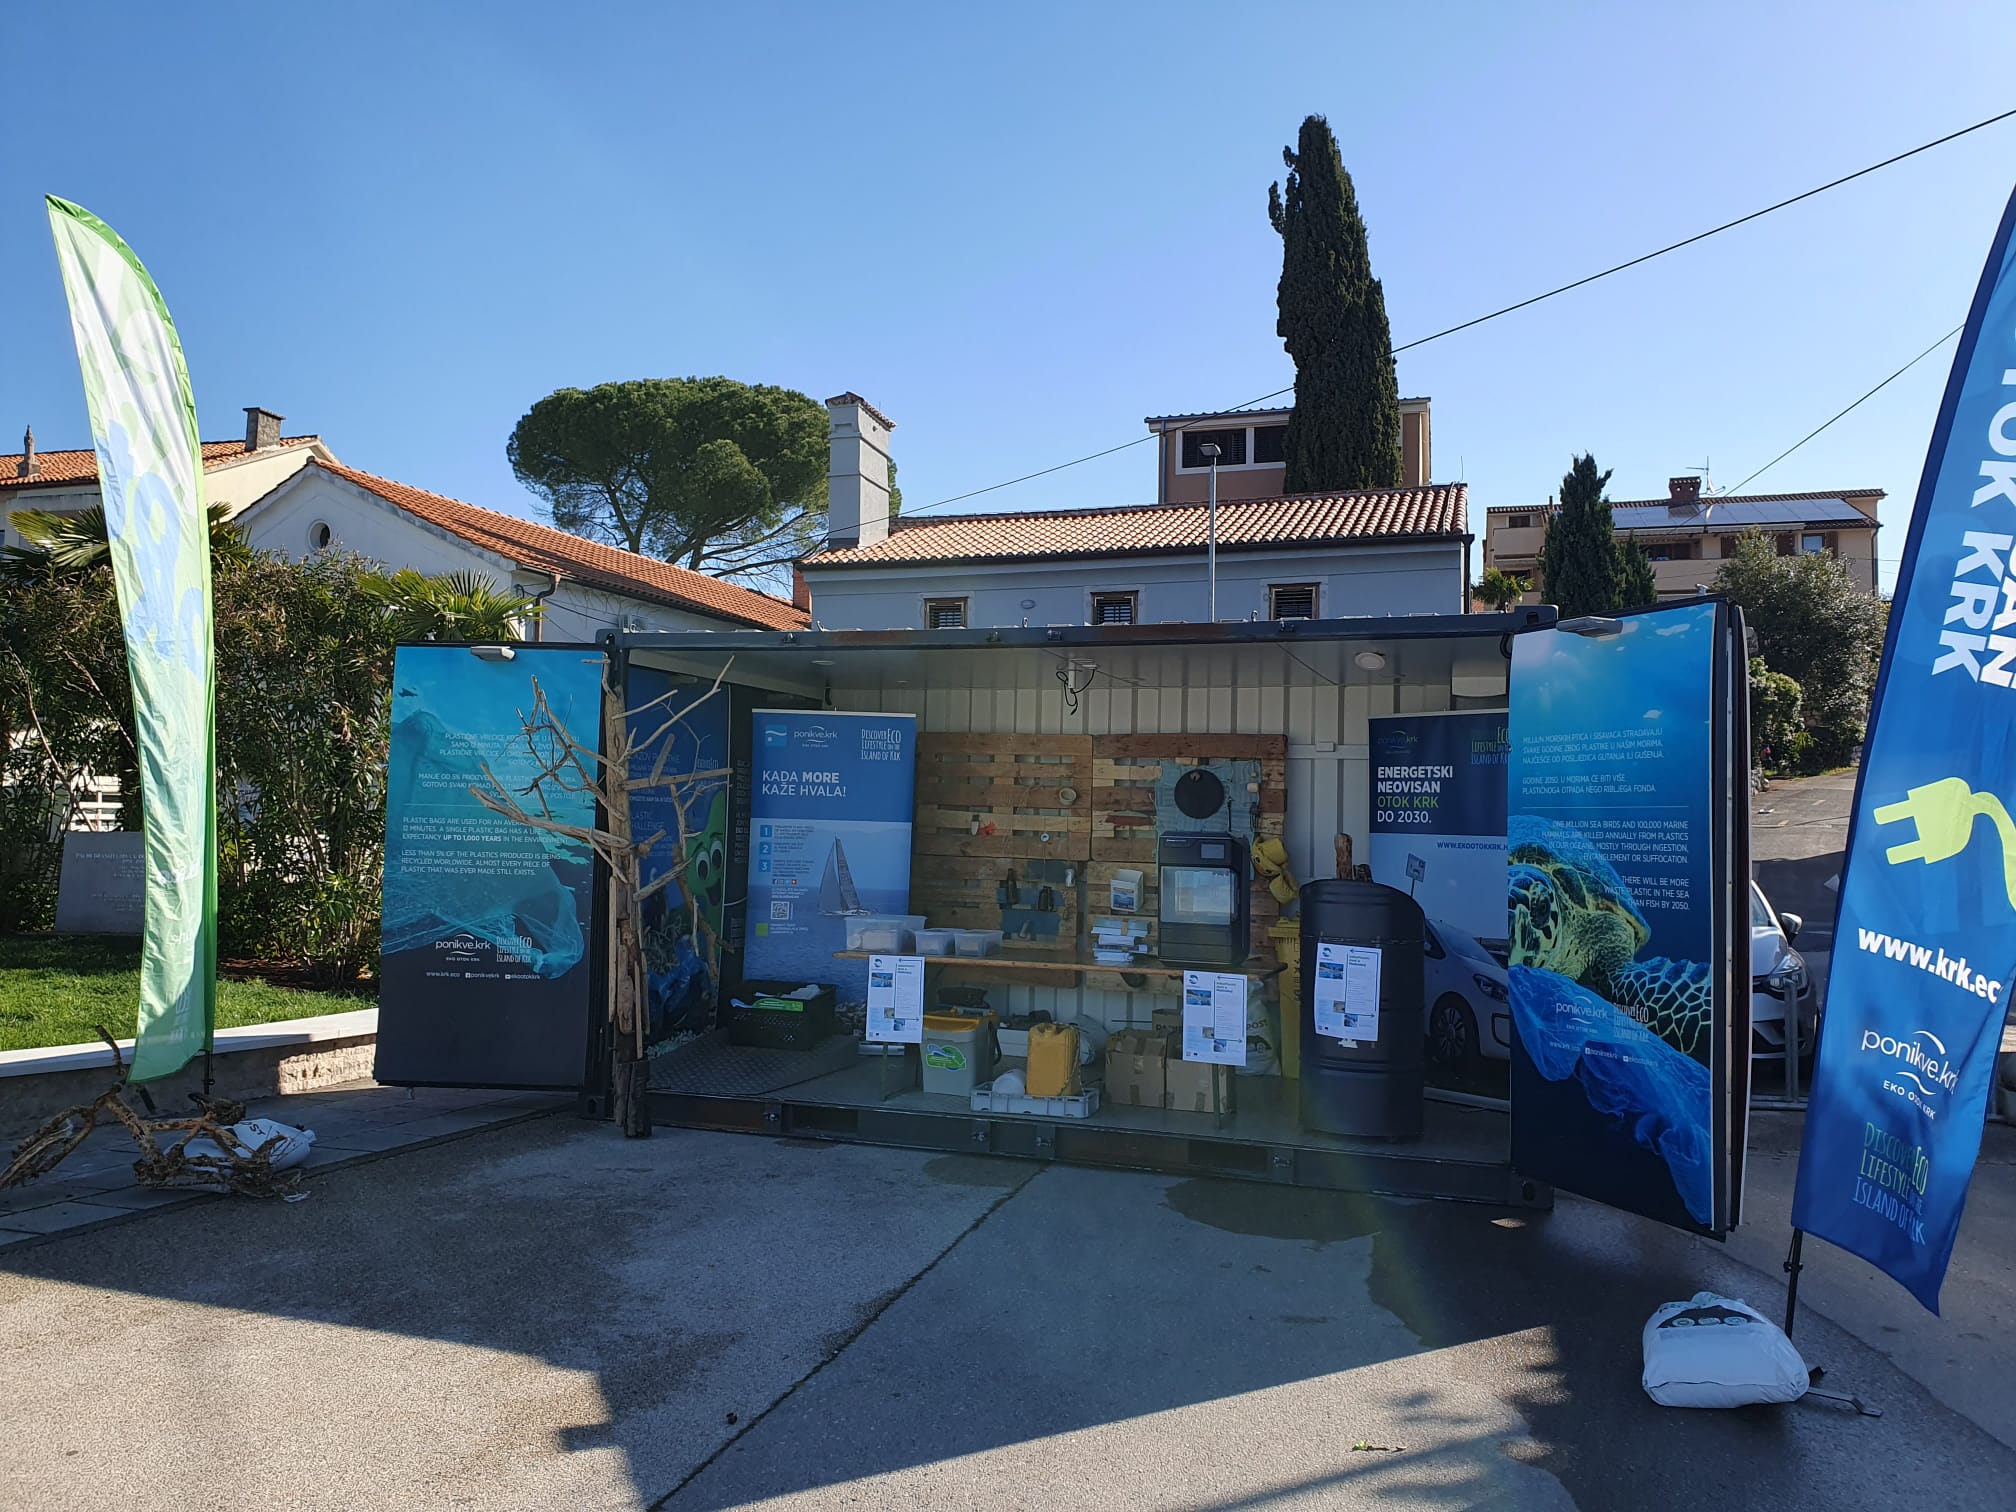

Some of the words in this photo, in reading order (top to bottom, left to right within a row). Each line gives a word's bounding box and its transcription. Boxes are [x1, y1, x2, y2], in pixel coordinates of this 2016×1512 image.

[1932, 530, 2013, 683] KRK
[887, 728, 901, 744] ECO
[861, 750, 881, 760] ISLAND
[763, 770, 798, 782] KADA
[803, 772, 839, 783] MORE
[1378, 766, 1453, 778] ENERGETSKI
[762, 782, 795, 796] KAŽE
[800, 785, 846, 796] HVALA!
[1378, 781, 1440, 793] NEOVISAN
[1378, 796, 1409, 808] OTOK
[1414, 796, 1439, 808] KRK
[1378, 811, 1394, 823] DO
[1398, 811, 1432, 823] 2030.
[1437, 842, 1508, 850] WWW.EKOOTOKKRK.H
[1621, 843, 1650, 851] THROUGH
[1643, 854, 1688, 864] SUFFOCATION.
[1621, 876, 1640, 884] THERE
[1643, 877, 1658, 885] WILL
[1670, 878, 1688, 887] MORE
[1662, 889, 1674, 897] THE
[1675, 889, 1689, 898] SEA
[1646, 900, 1660, 908] FISH
[1672, 901, 1690, 910] 2050.
[435, 938, 491, 950] ponikve.krk
[520, 936, 532, 948] ECO
[1858, 928, 2003, 1004] www.krk.ec
[1635, 1004, 1649, 1022] ECO
[1883, 1080, 1905, 1096] EKO
[1912, 1146, 1929, 1196] ECO
[1852, 1176, 1899, 1222] ISLAND
